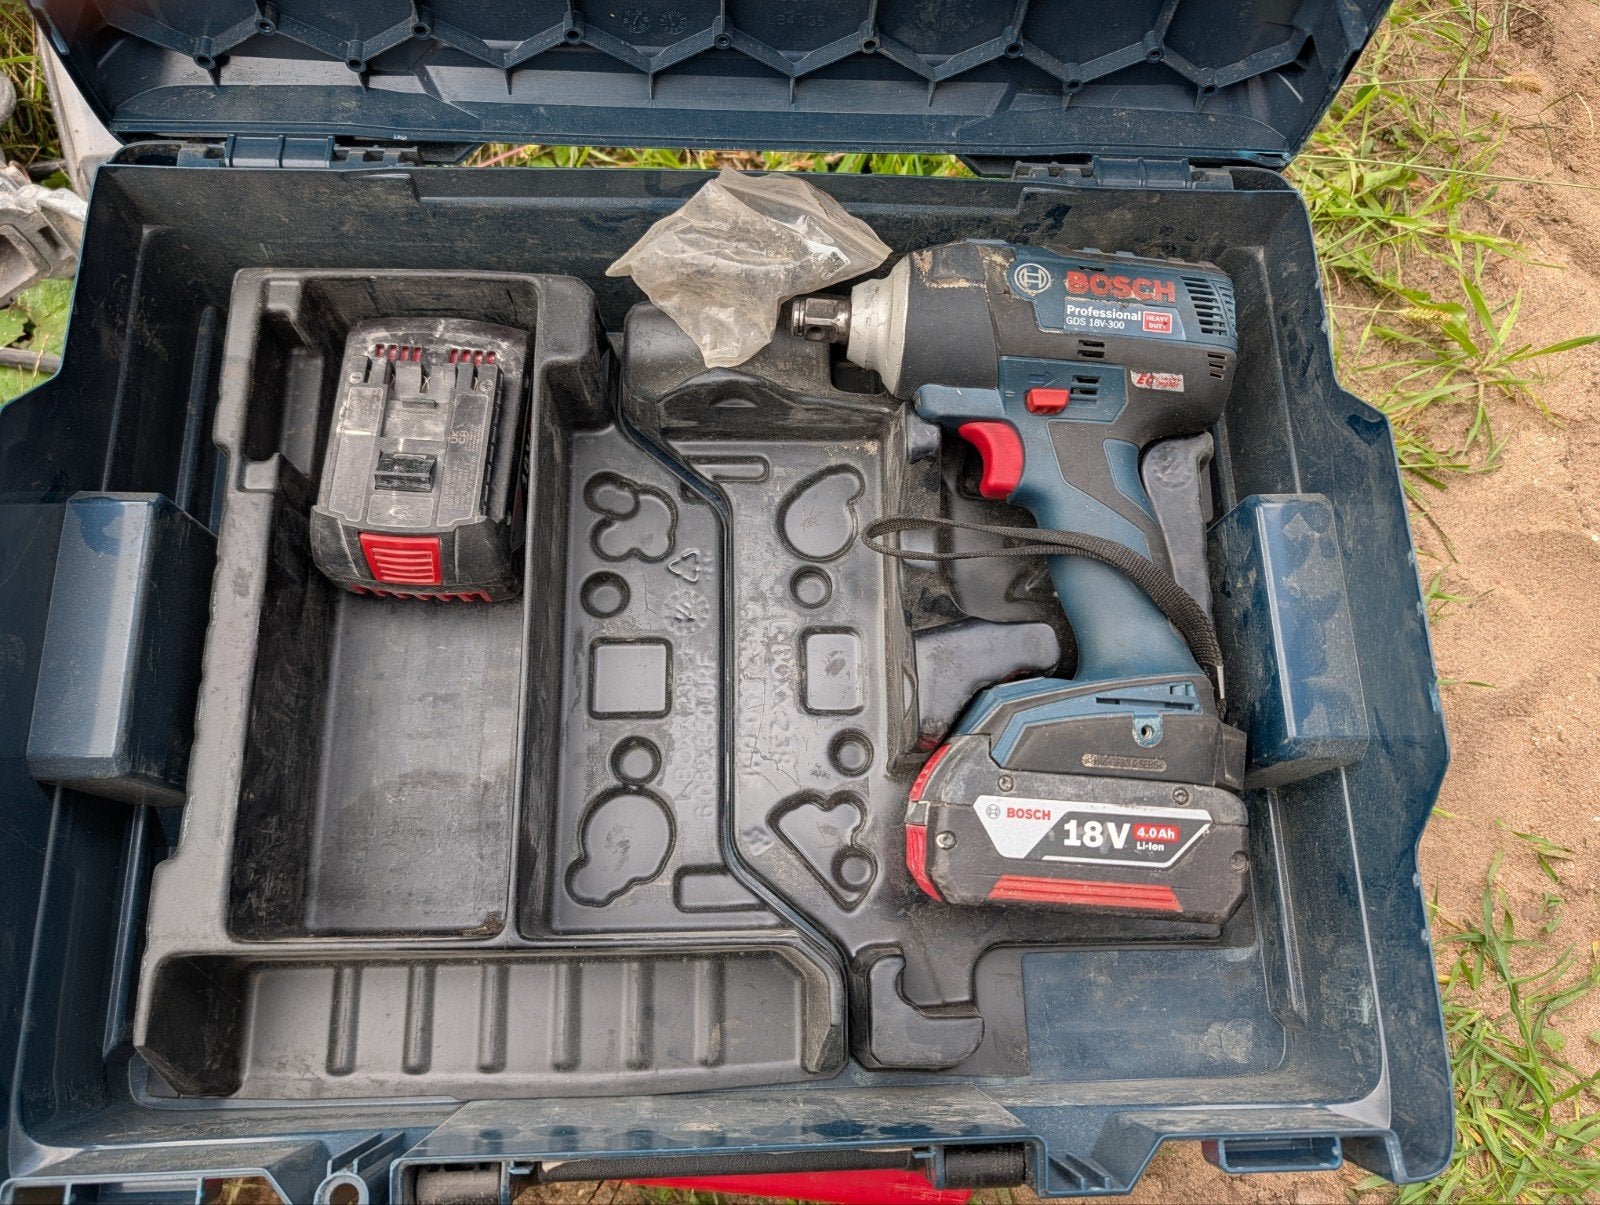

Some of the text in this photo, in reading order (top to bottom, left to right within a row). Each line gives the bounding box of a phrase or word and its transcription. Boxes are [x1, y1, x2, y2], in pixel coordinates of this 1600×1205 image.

[1064, 270, 1176, 303] BOSCH
[1066, 304, 1142, 322] Professional
[1145, 314, 1169, 323] HEAVY
[1065, 316, 1126, 330] GDS 18V-300
[1006, 807, 1051, 821] BOSCH
[1062, 819, 1131, 850] 18V
[1136, 840, 1165, 852] Li-Ion
